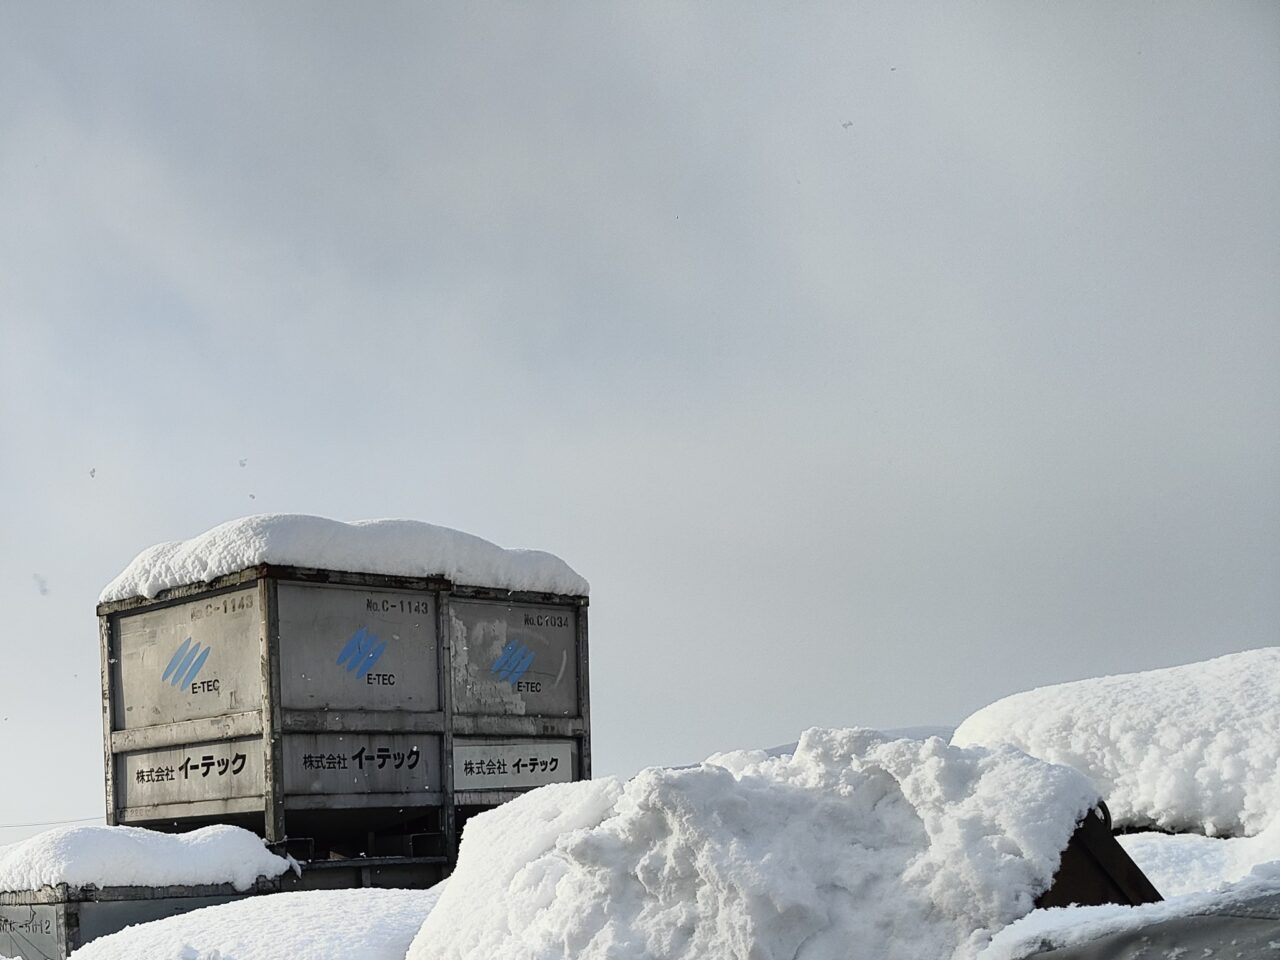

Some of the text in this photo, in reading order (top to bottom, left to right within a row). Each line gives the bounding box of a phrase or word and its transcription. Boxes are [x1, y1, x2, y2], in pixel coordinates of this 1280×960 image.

[367, 673, 395, 686] E-TEC
[191, 679, 220, 695] E-TEC
[517, 681, 542, 693] E-TEC
